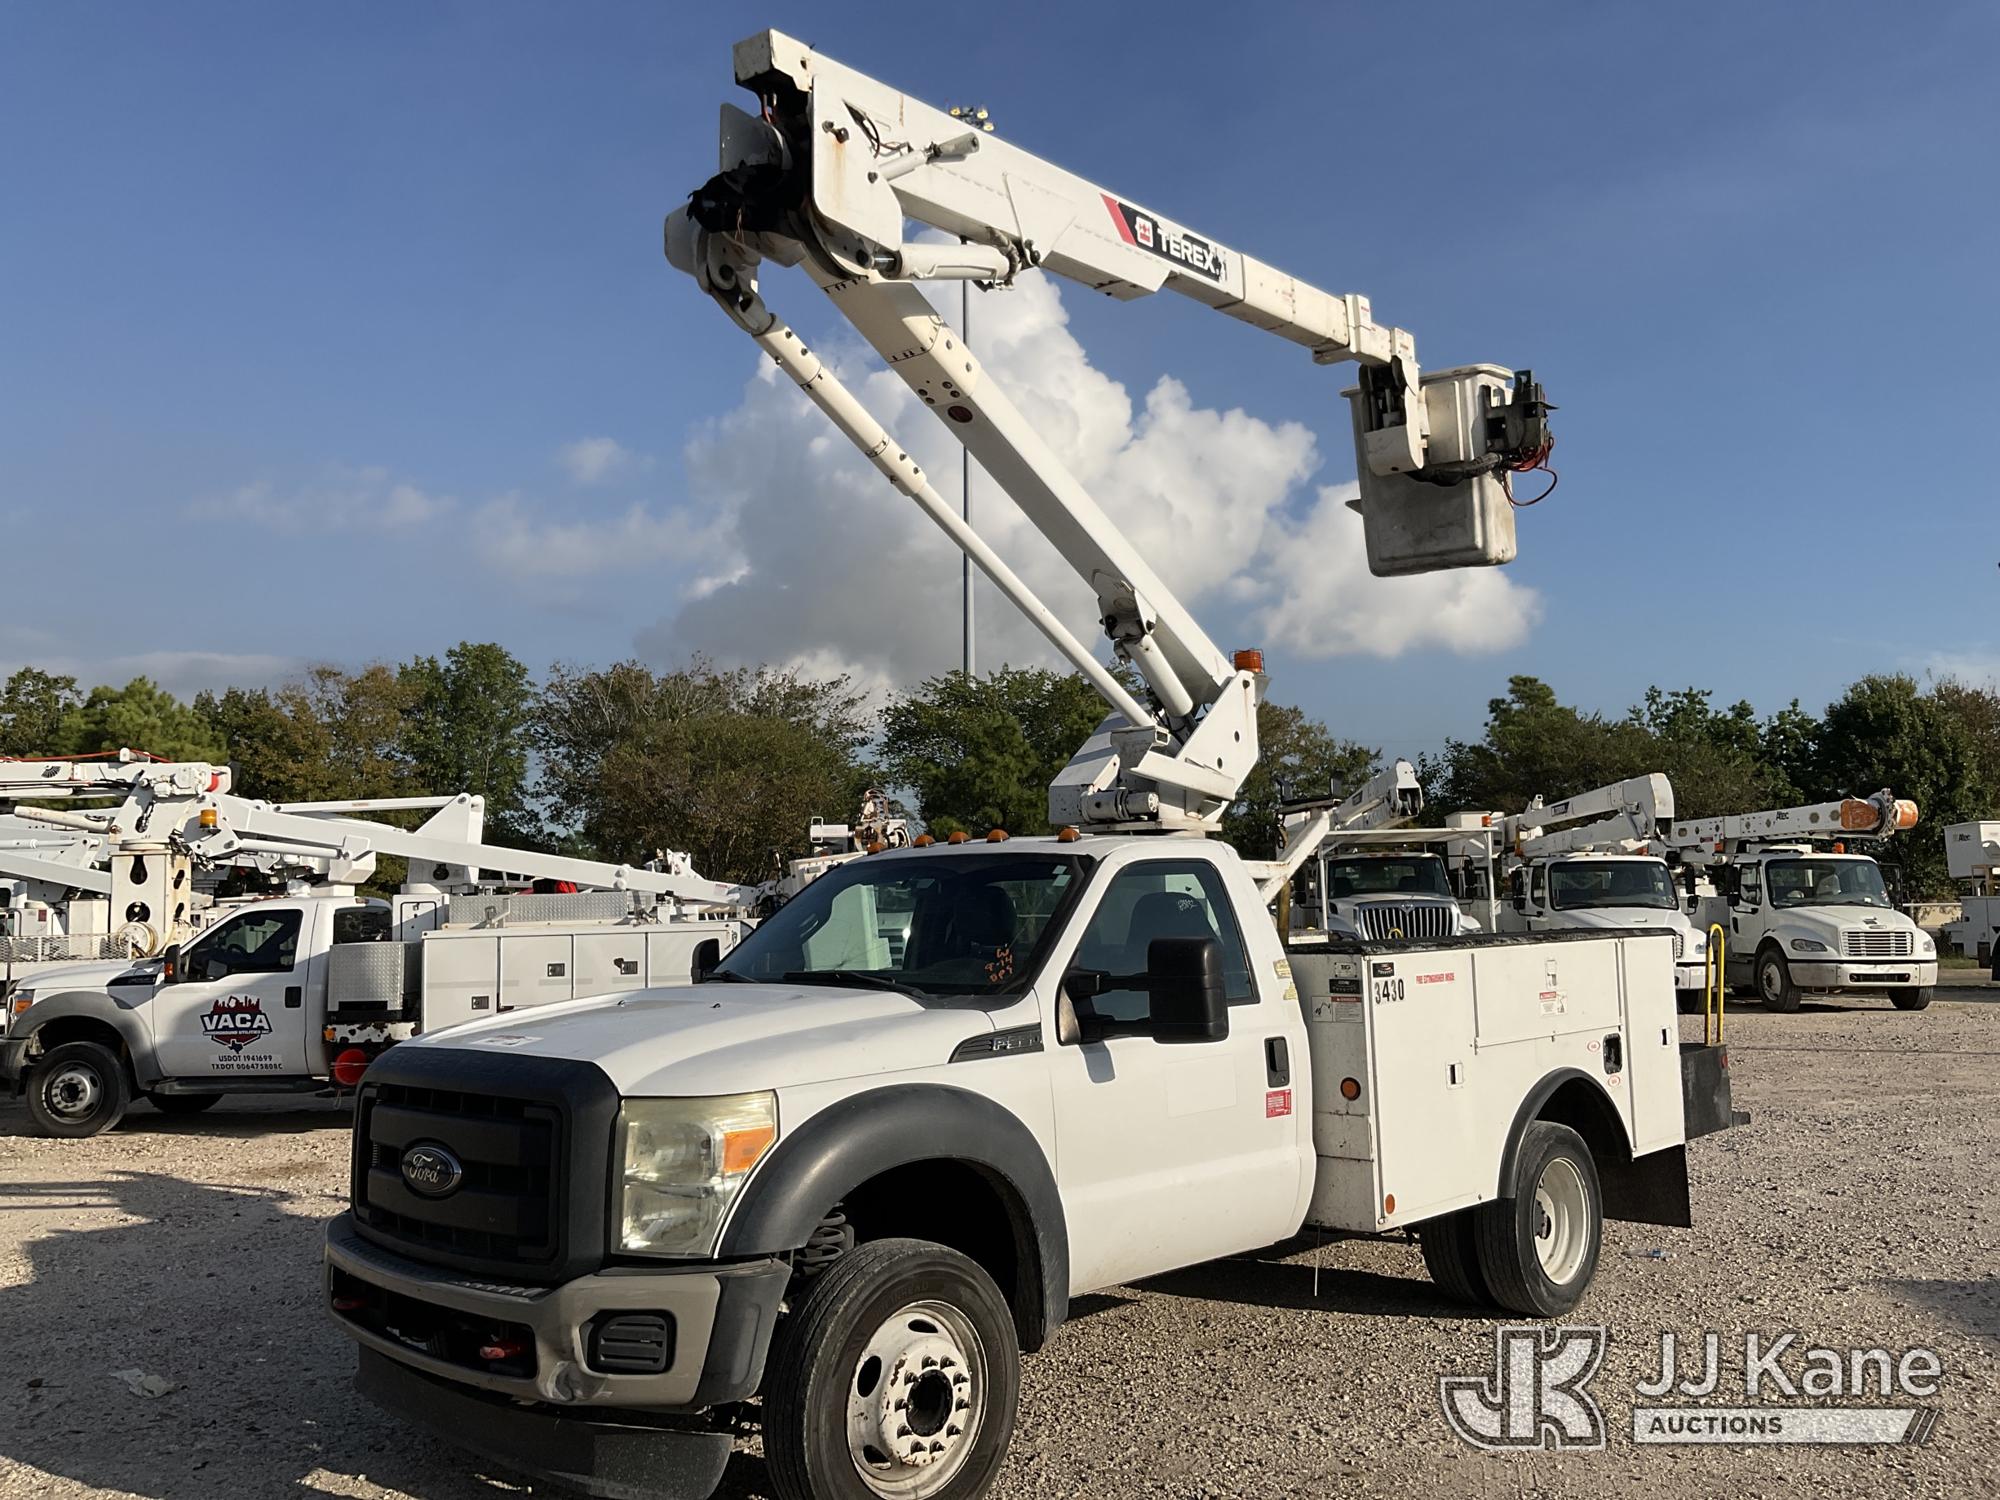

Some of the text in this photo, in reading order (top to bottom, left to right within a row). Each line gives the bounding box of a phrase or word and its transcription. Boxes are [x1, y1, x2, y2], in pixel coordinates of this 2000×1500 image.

[1157, 227, 1216, 274] TEREX
[1374, 978, 1405, 1005] 3430
[203, 1012, 270, 1031] VACA
[211, 1062, 235, 1071] TXDOT
[218, 1054, 273, 1062] USDOT 1941699
[409, 1153, 440, 1184] Ford
